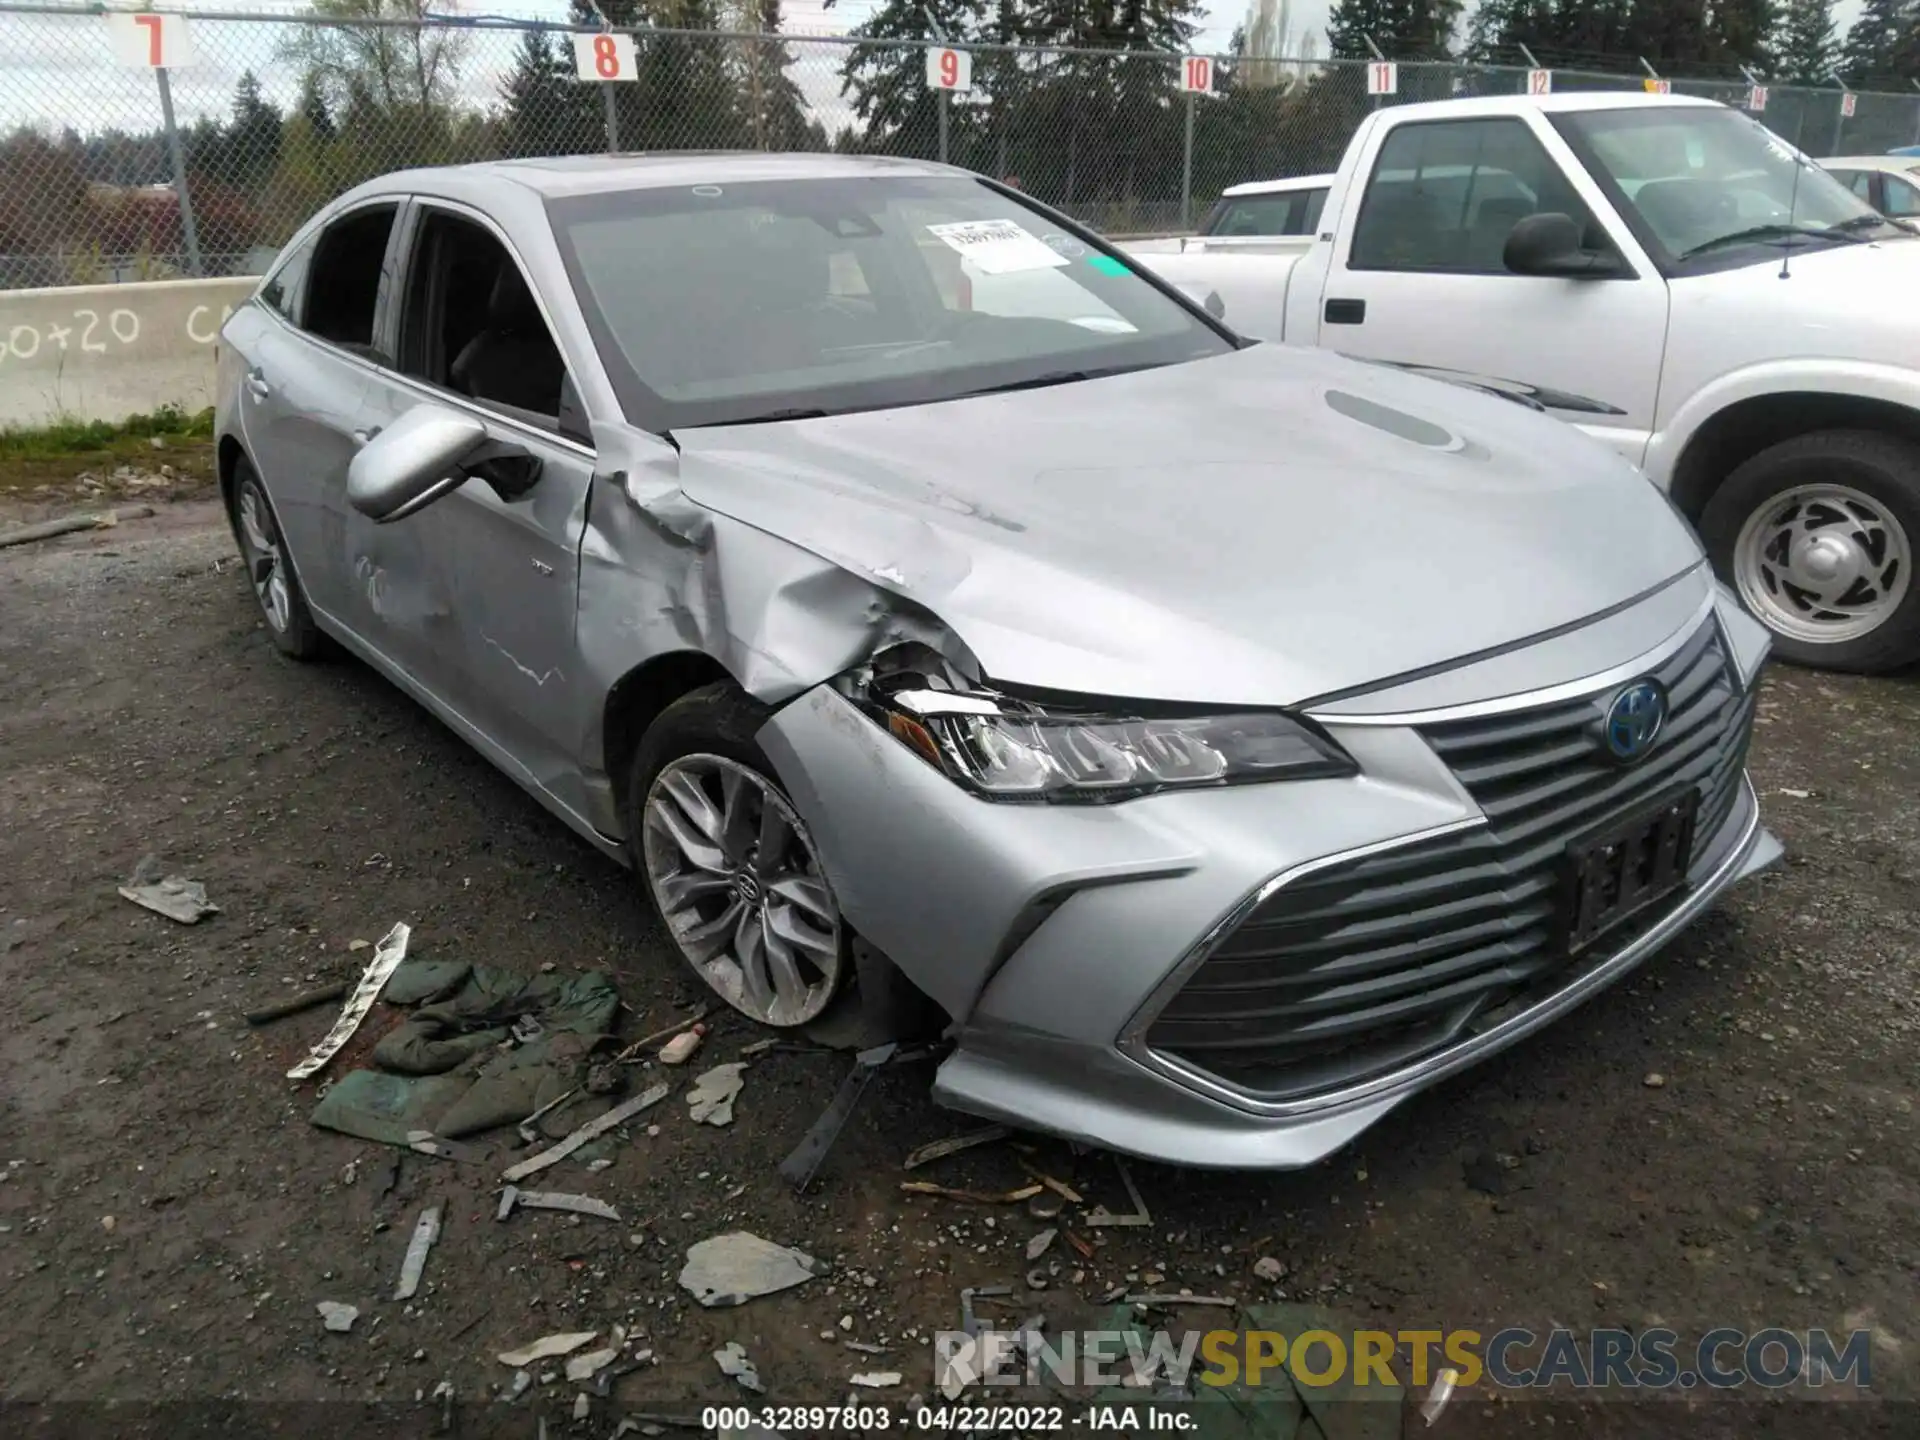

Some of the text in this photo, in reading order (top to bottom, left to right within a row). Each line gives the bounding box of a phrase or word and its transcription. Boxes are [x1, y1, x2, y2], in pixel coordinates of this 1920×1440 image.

[135, 15, 161, 65] 7
[594, 35, 619, 78] 8
[941, 51, 958, 86] 9
[1187, 58, 1208, 90] 10
[1375, 66, 1389, 92] 11
[1531, 71, 1548, 94] 12
